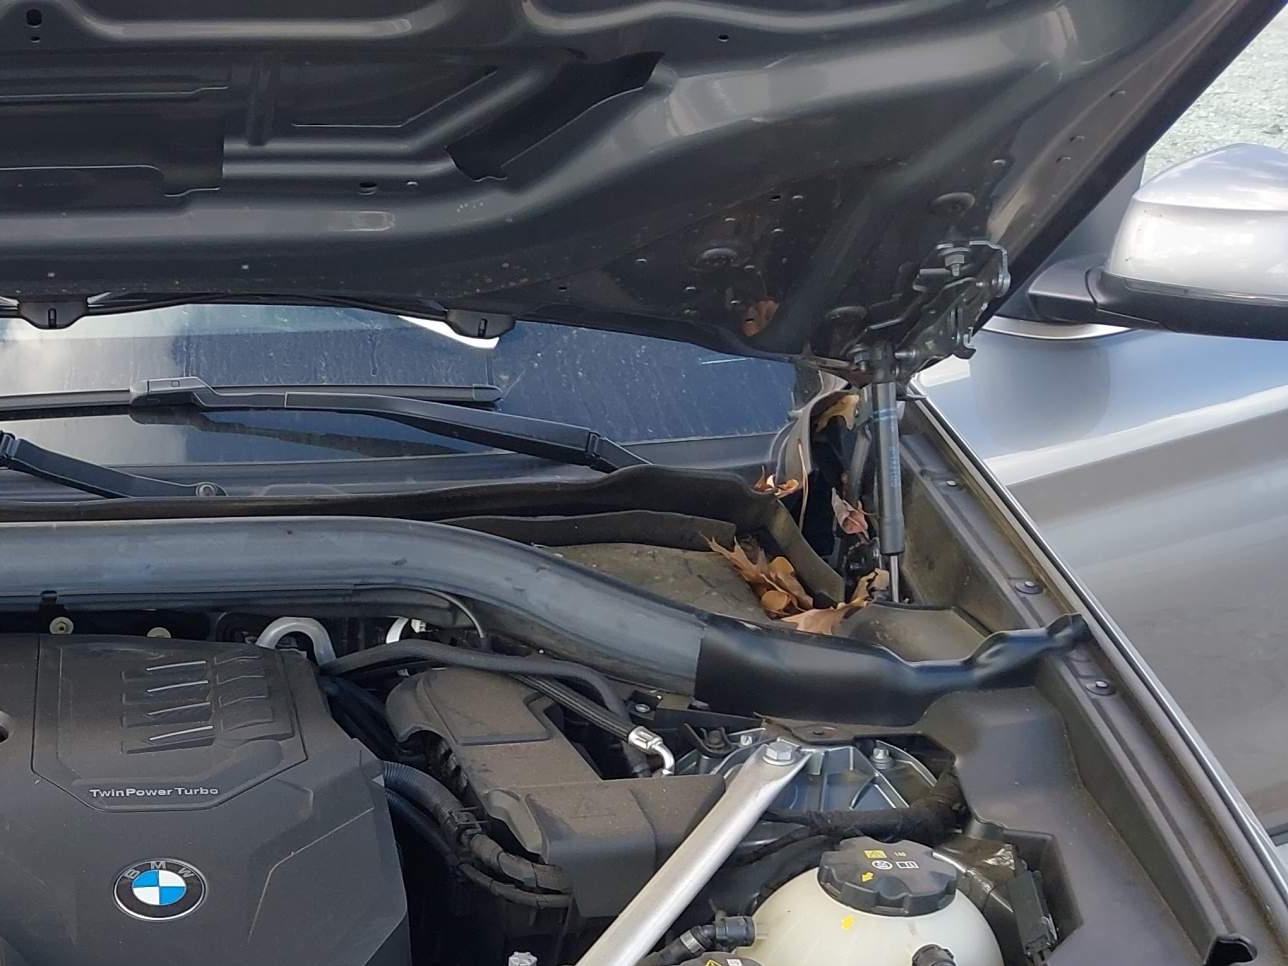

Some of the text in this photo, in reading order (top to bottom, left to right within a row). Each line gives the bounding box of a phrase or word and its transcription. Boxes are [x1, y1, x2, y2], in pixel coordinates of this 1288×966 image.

[89, 787, 219, 798] TwinPower Turbo
[123, 860, 195, 880] BMW
